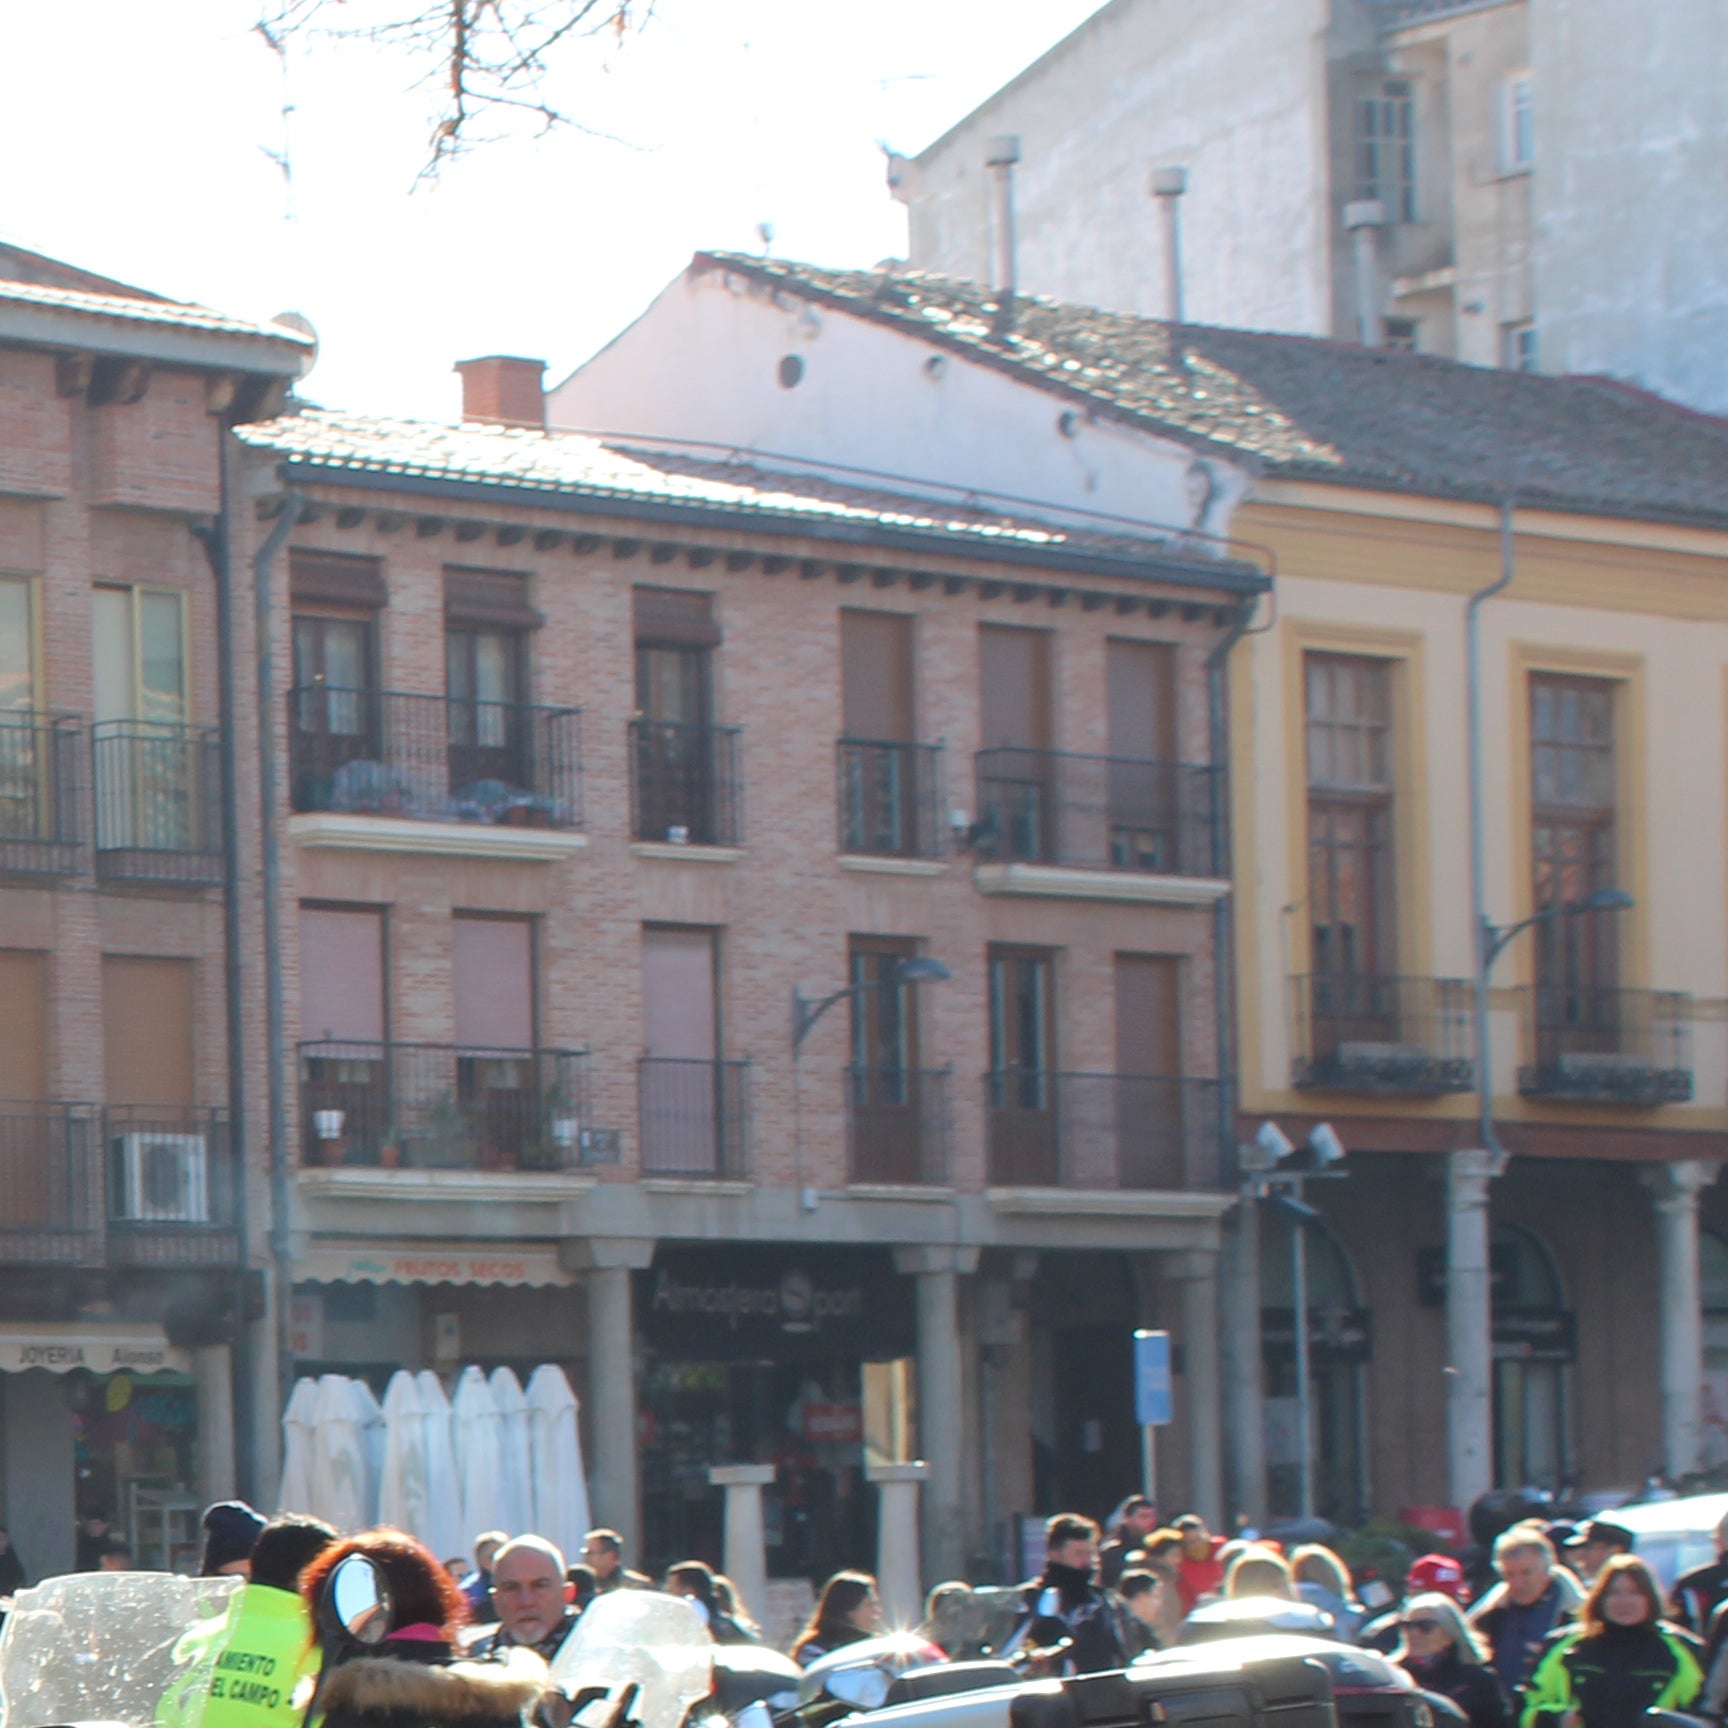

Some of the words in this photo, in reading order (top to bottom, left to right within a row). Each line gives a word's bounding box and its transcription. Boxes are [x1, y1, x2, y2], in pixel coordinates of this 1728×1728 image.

[393, 1259, 461, 1277] FRUTOS
[468, 1261, 526, 1279] SECOS
[230, 1679, 280, 1709] CAMPO
